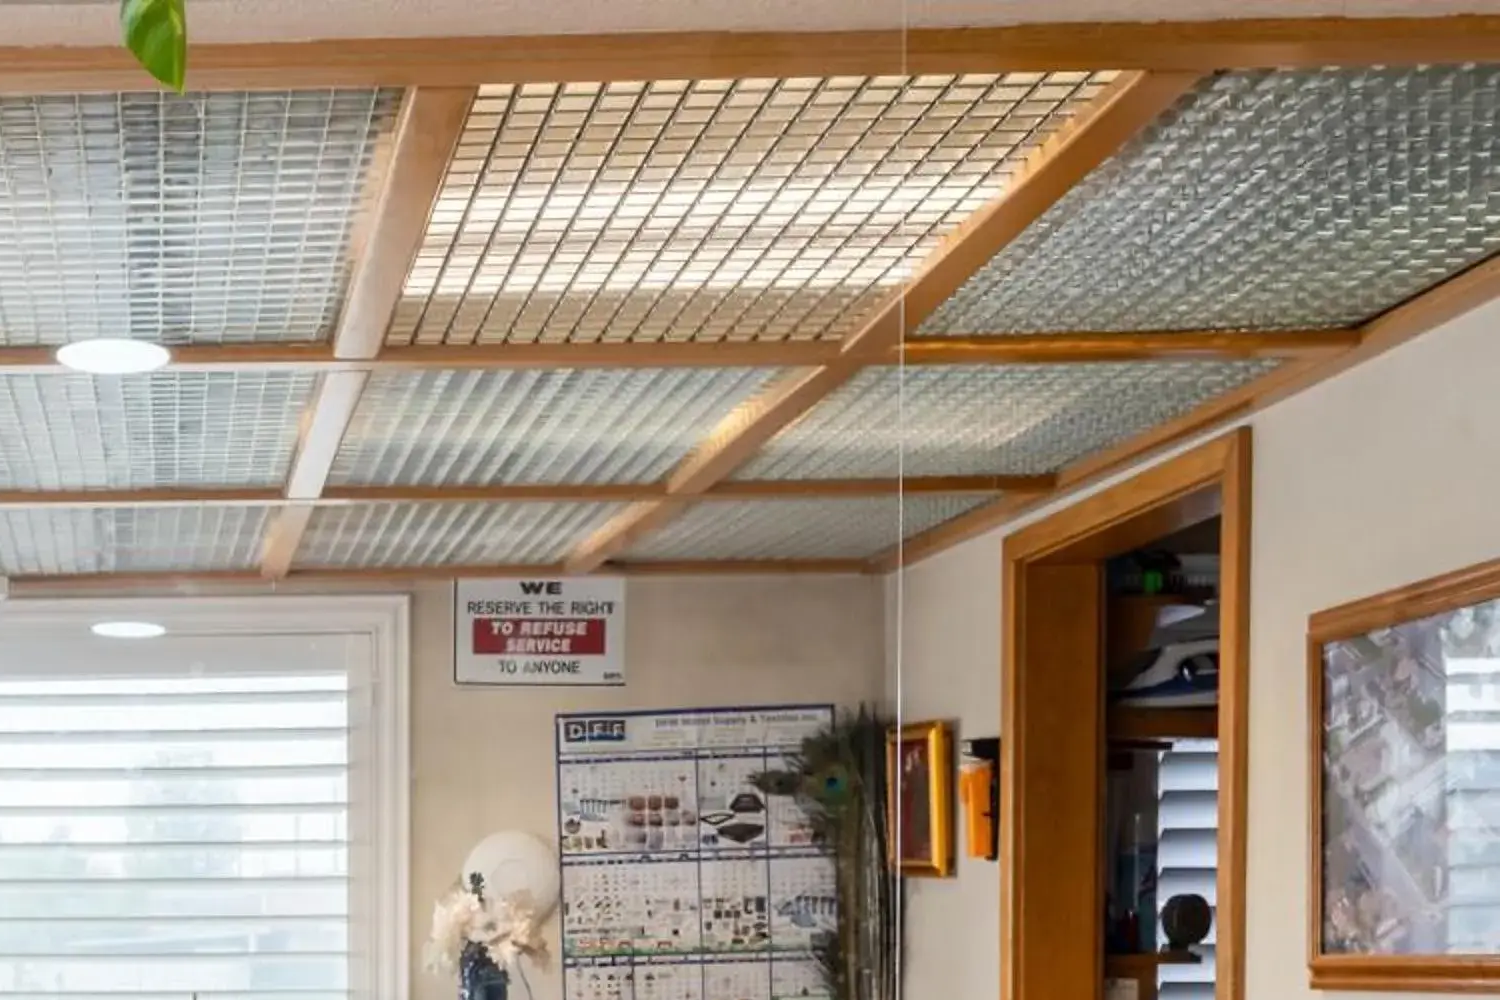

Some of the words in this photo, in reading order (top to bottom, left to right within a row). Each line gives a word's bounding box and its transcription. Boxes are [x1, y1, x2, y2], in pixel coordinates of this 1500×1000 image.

[519, 581, 563, 595] WE
[467, 600, 533, 615] RESERVE
[539, 601, 565, 615] THE
[570, 601, 615, 615] RIGHT
[491, 621, 514, 636] TO
[520, 621, 588, 636] REFUSE
[506, 638, 572, 653] SERVICE
[499, 660, 518, 674] TO
[522, 660, 581, 674] ANYONE
